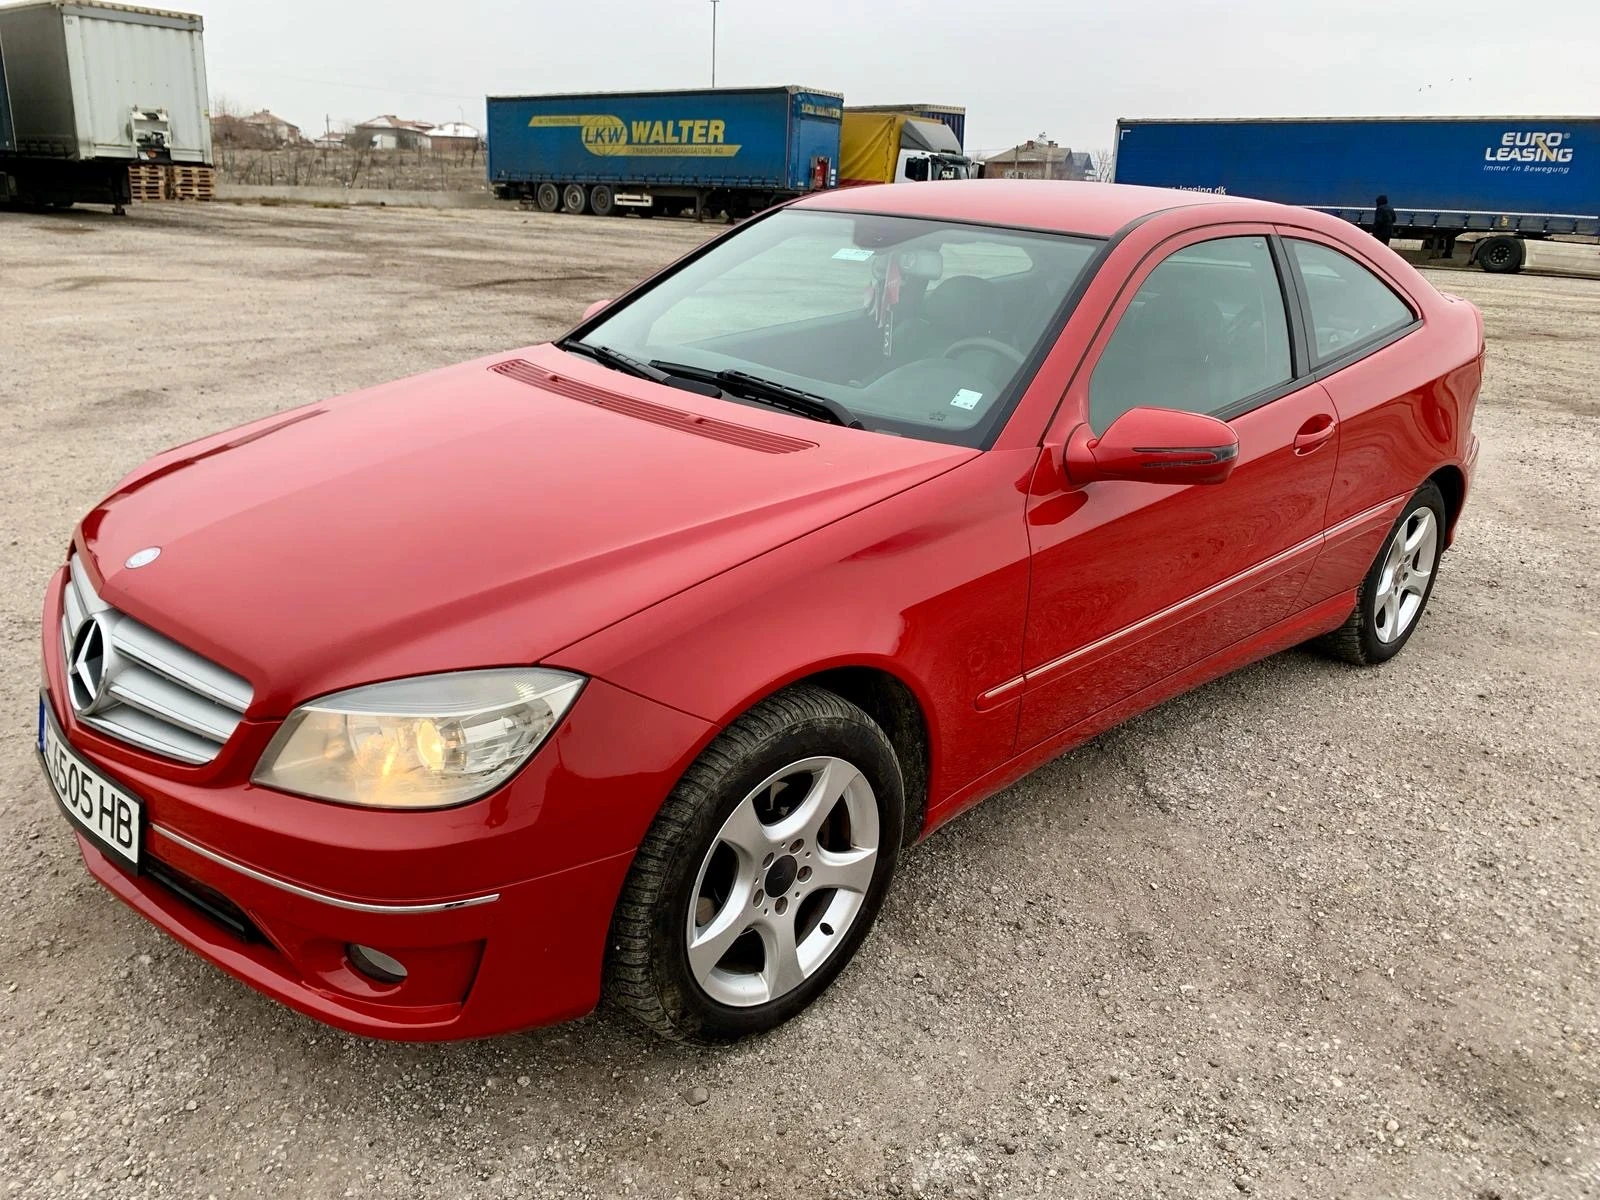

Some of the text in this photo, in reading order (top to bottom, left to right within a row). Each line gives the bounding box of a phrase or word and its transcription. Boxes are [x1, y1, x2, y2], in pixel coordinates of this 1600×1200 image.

[584, 120, 725, 145] LKW WALTER
[1501, 132, 1562, 147] EURO
[1485, 147, 1573, 162] LEASING
[1524, 165, 1570, 175] Bewegung
[53, 741, 93, 819] 6505
[98, 784, 133, 849] HB
